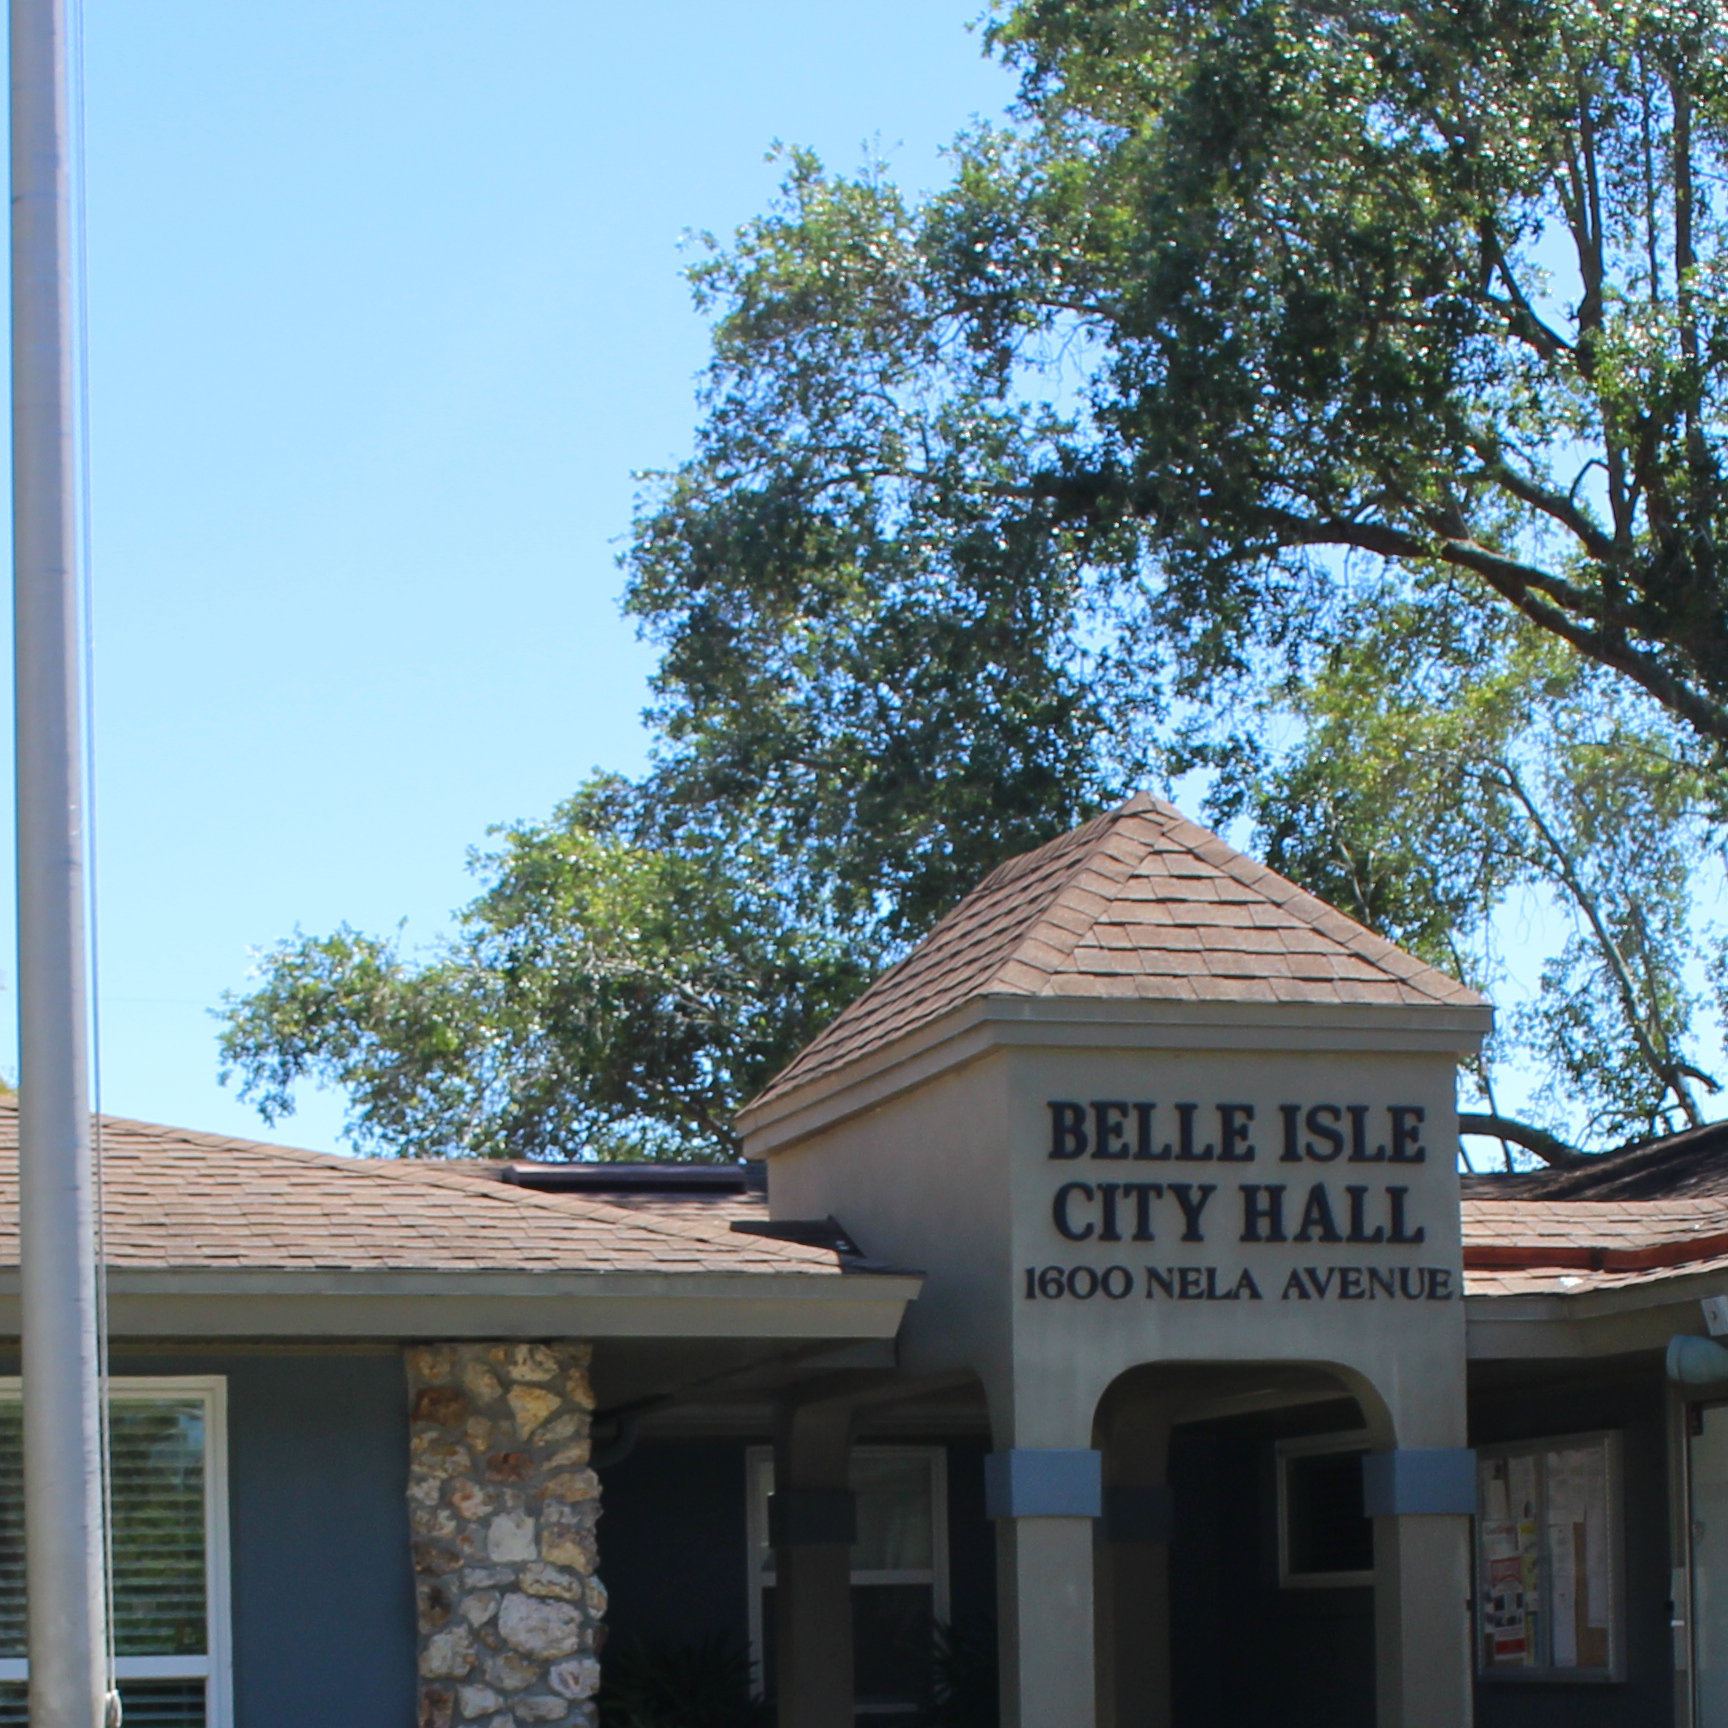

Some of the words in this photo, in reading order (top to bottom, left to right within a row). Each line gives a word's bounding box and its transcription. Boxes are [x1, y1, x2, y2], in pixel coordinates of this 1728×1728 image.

[1047, 1101, 1256, 1162] BELLE
[1278, 1104, 1426, 1163] ISLE
[1052, 1182, 1217, 1242] CITY
[1238, 1182, 1425, 1244] HALL
[1024, 1265, 1134, 1299] 1600
[1145, 1266, 1262, 1299] NELA
[1282, 1267, 1453, 1299] AVENUE
